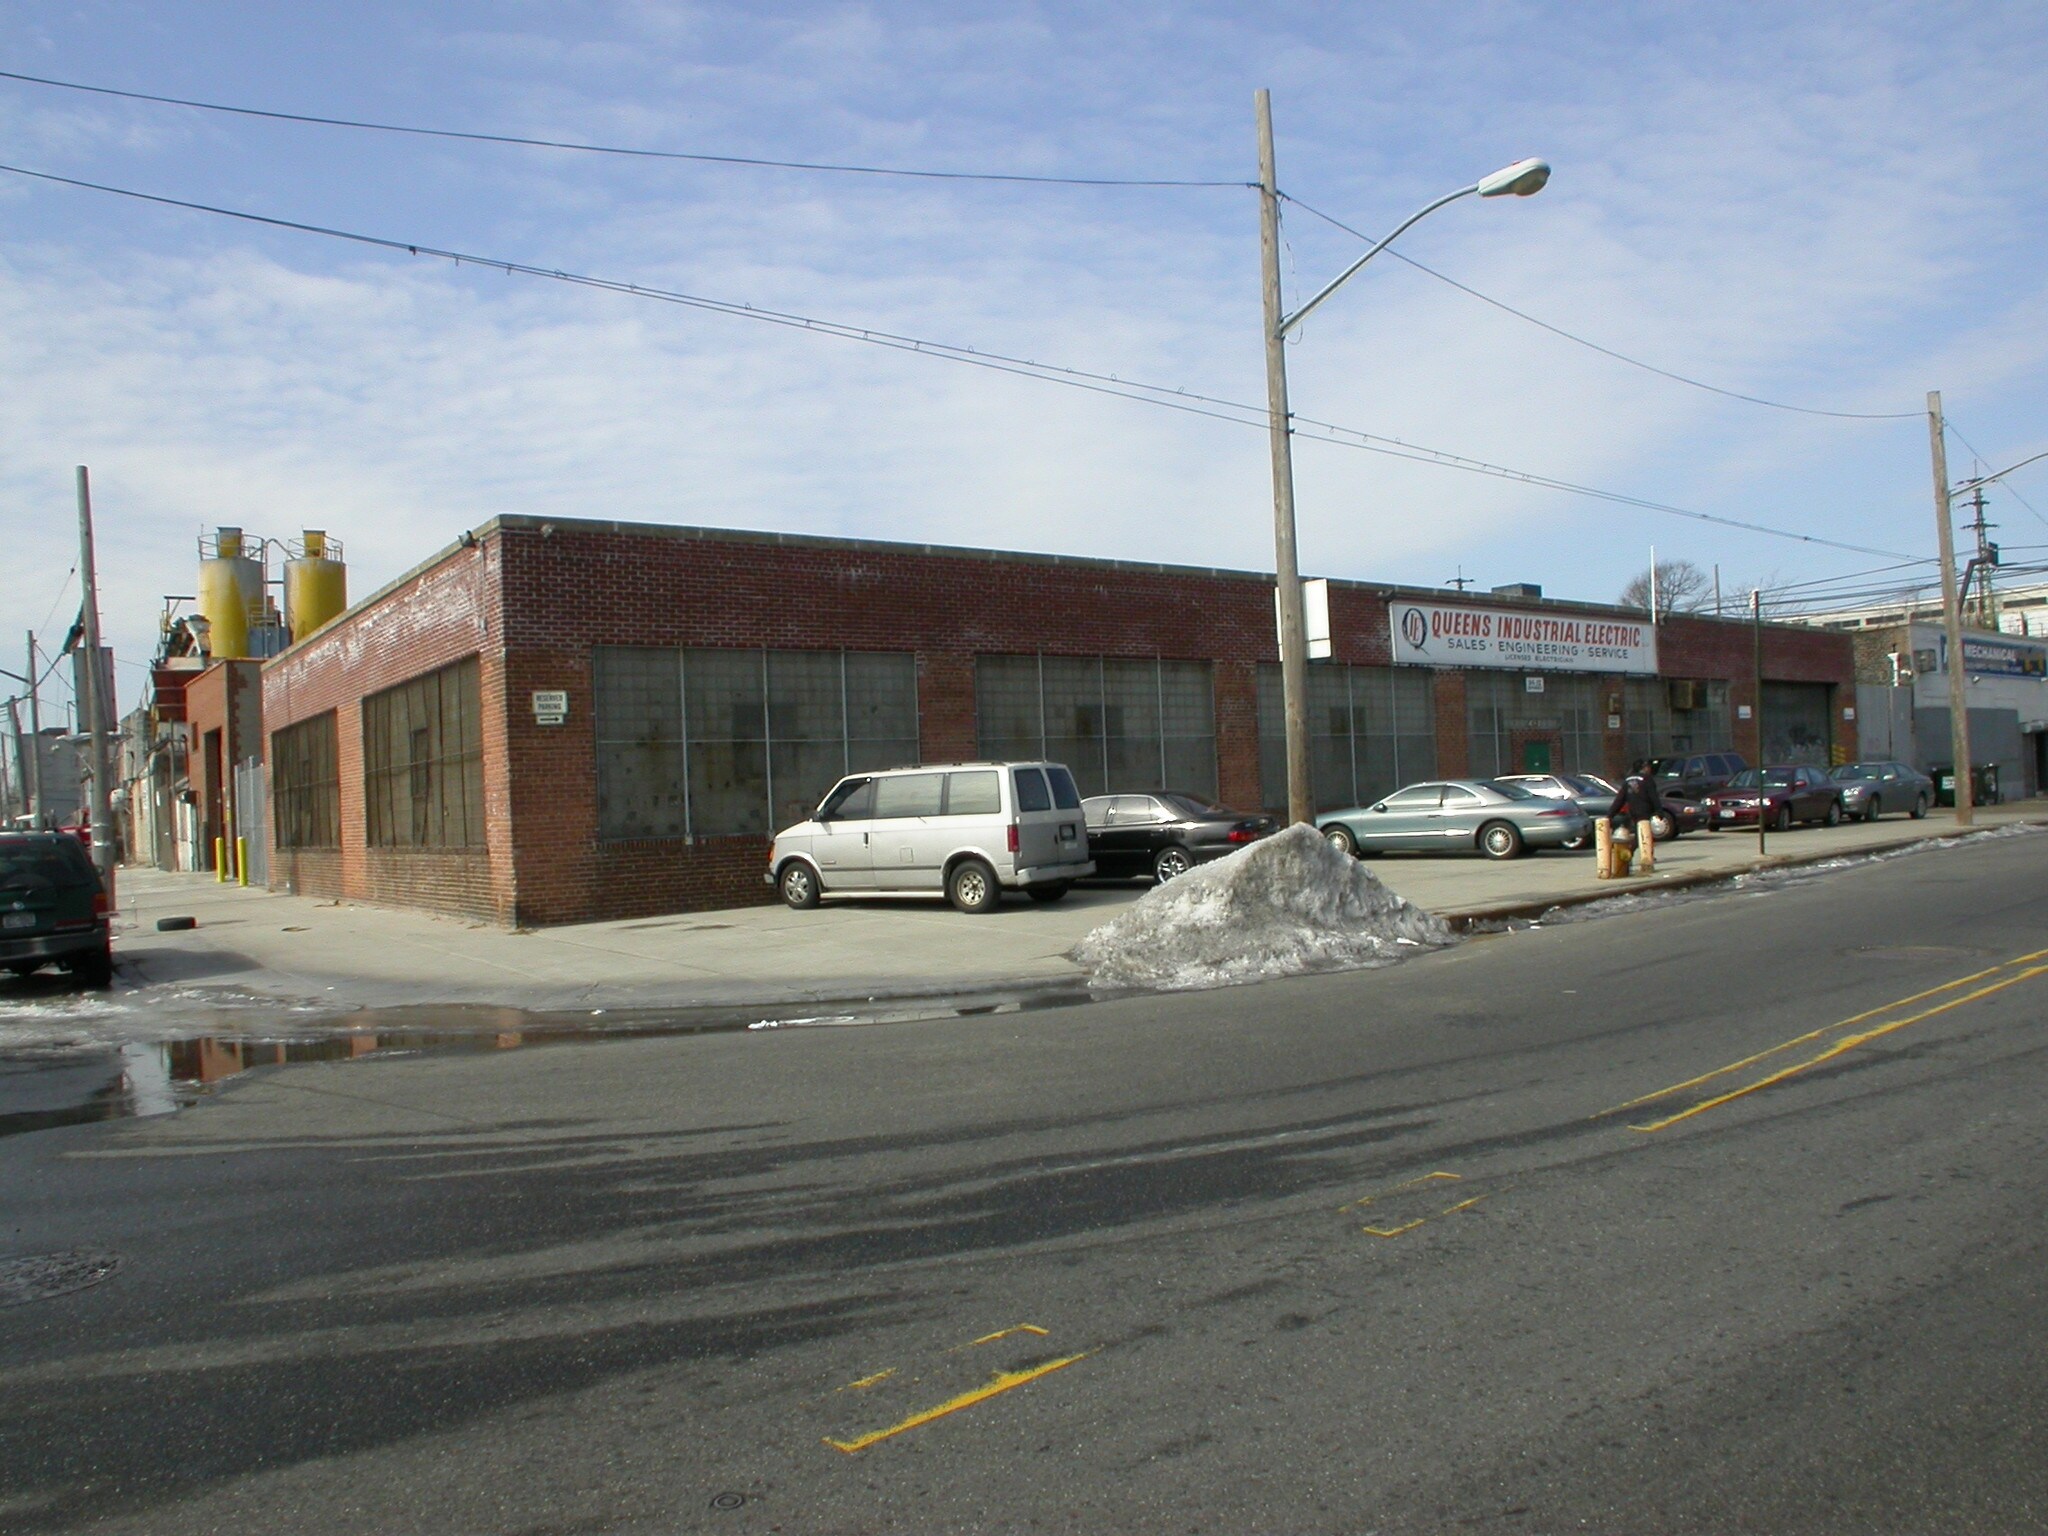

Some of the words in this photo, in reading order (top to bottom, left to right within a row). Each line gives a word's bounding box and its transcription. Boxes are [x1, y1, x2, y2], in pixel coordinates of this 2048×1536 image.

[1432, 610, 1491, 639] QUEENS
[1497, 616, 1582, 643] INDUSTRIAL
[1584, 623, 1641, 647] ELECTRIC
[1448, 638, 1486, 651] SALES
[1498, 641, 1579, 656] ENGINEERING
[1588, 646, 1629, 659] SERVICE
